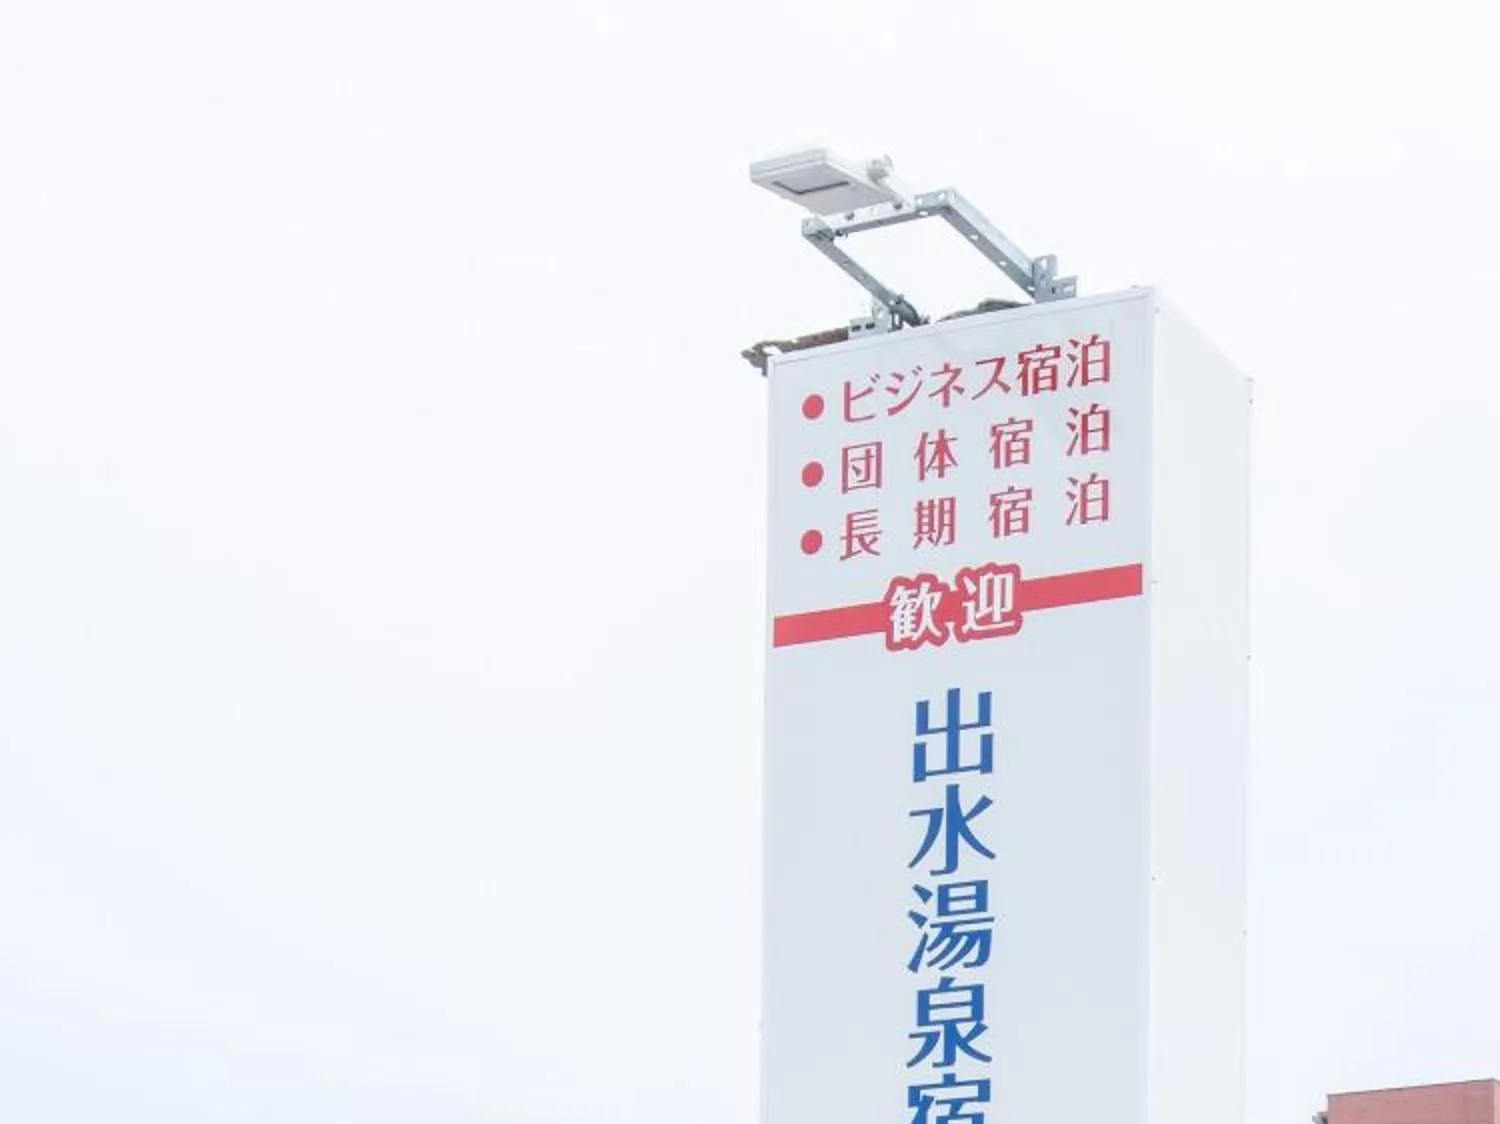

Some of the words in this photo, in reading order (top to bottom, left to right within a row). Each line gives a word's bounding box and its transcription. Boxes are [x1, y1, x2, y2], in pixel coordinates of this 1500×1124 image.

[841, 334, 1111, 423] ビジネス宿泊
[888, 571, 1015, 643] 歓迎
